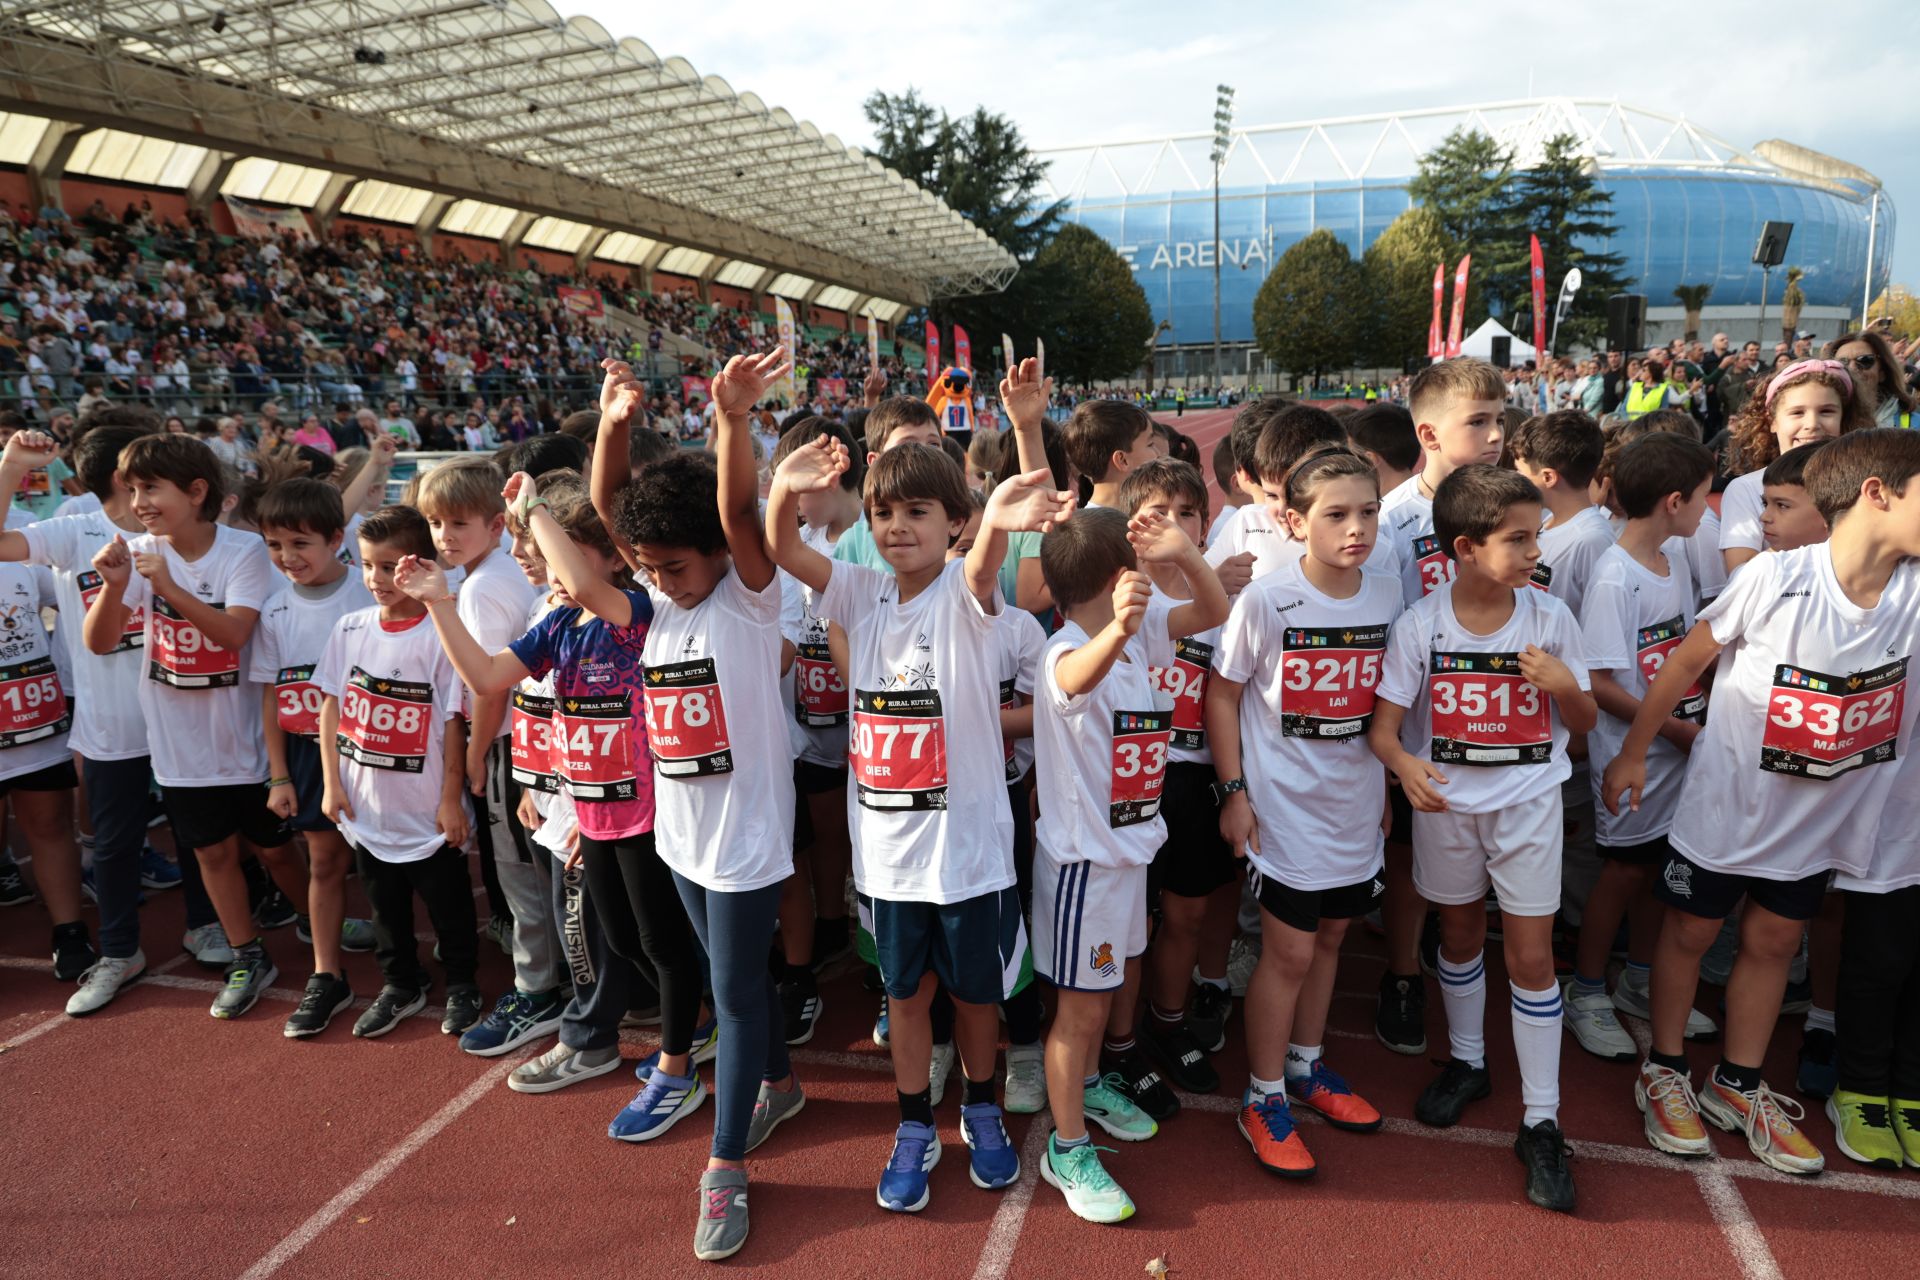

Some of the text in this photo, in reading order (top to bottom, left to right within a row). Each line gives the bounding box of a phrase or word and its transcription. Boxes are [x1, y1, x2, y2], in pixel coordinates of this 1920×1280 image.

[1150, 238, 1267, 270] ARENA
[684, 668, 708, 677] KUTXA
[1284, 655, 1379, 691] 3215
[0, 676, 58, 712] 195
[1328, 696, 1348, 708] IAN
[1433, 681, 1541, 717] 3513
[12, 711, 40, 723] UXUE
[343, 691, 421, 734] 3068
[1467, 722, 1507, 733] HUGO
[1770, 690, 1895, 736] 3362
[511, 718, 552, 751] 13
[553, 717, 620, 757] 3347
[850, 719, 931, 760] 3077
[1813, 736, 1855, 752] MARC
[865, 764, 892, 777] OIER
[1114, 741, 1168, 778] 33
[564, 886, 593, 985] Quiksilver
